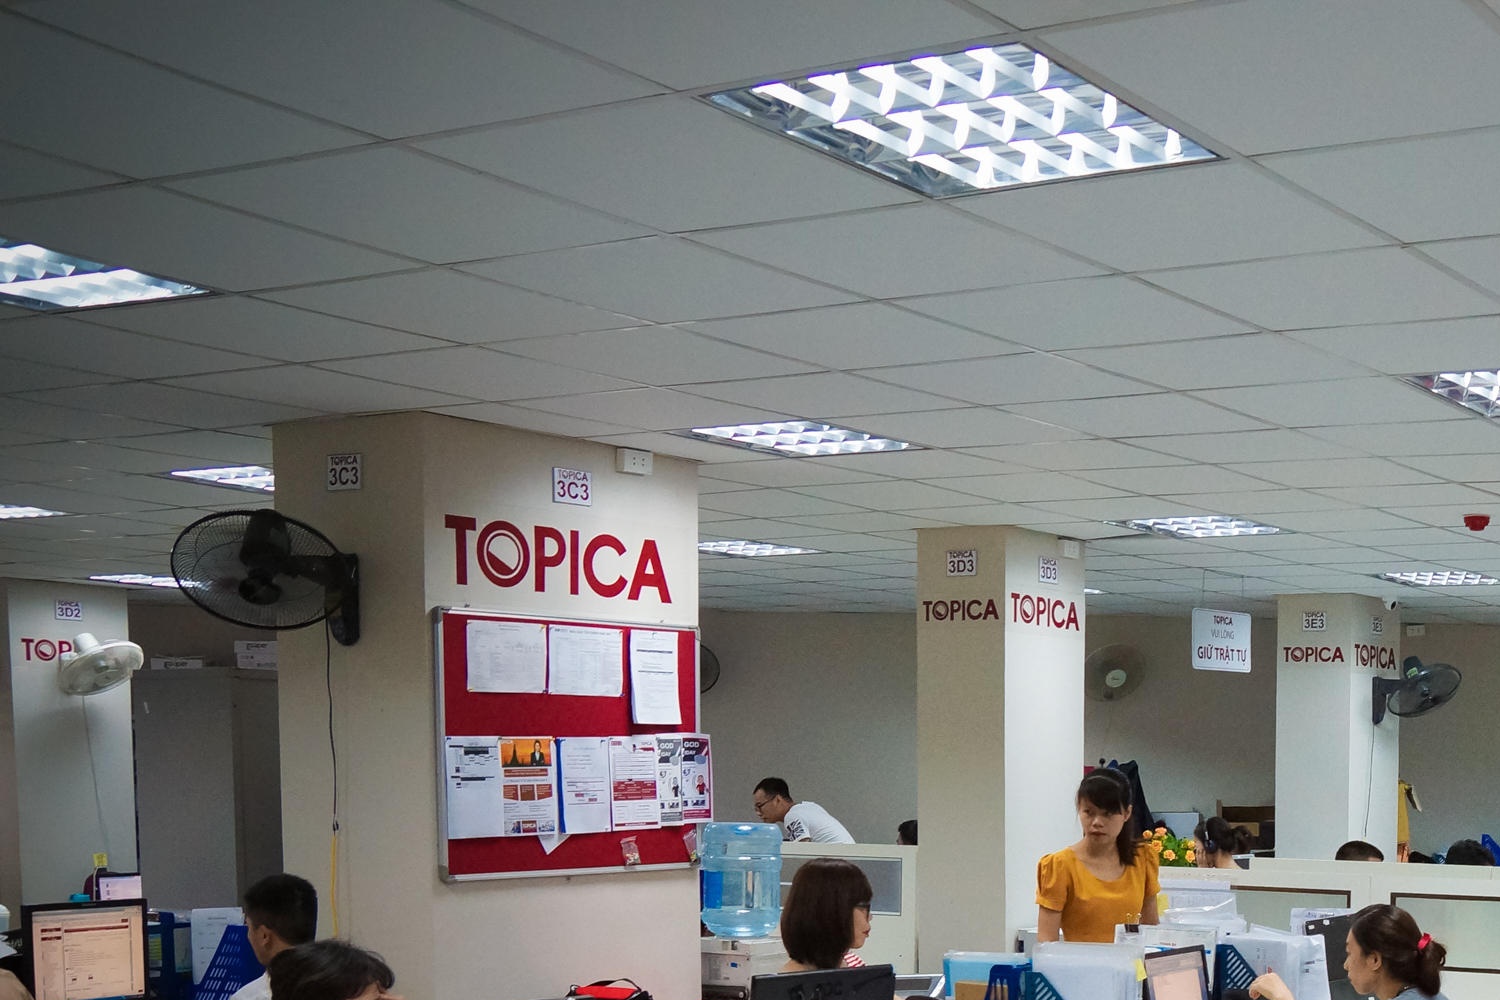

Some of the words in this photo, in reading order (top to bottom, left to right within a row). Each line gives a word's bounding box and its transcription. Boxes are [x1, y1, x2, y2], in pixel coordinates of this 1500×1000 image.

[331, 455, 358, 465] TOPICA
[329, 466, 359, 486] 3C3
[558, 469, 588, 482] TOPICA
[557, 480, 589, 500] 3C3
[445, 514, 673, 604] TOPICA
[950, 551, 973, 559] TOPICA
[948, 559, 974, 573] 3D3
[1041, 566, 1057, 580] 3D3
[57, 606, 81, 618] 3D2
[923, 599, 999, 621] TOPICA
[1011, 592, 1079, 631] TOPICA
[1213, 615, 1233, 625] TOPICA
[1304, 618, 1325, 629] 3E3
[21, 638, 73, 661] TOP
[1283, 646, 1344, 662] TOPICA
[1355, 643, 1396, 670] TOPICA
